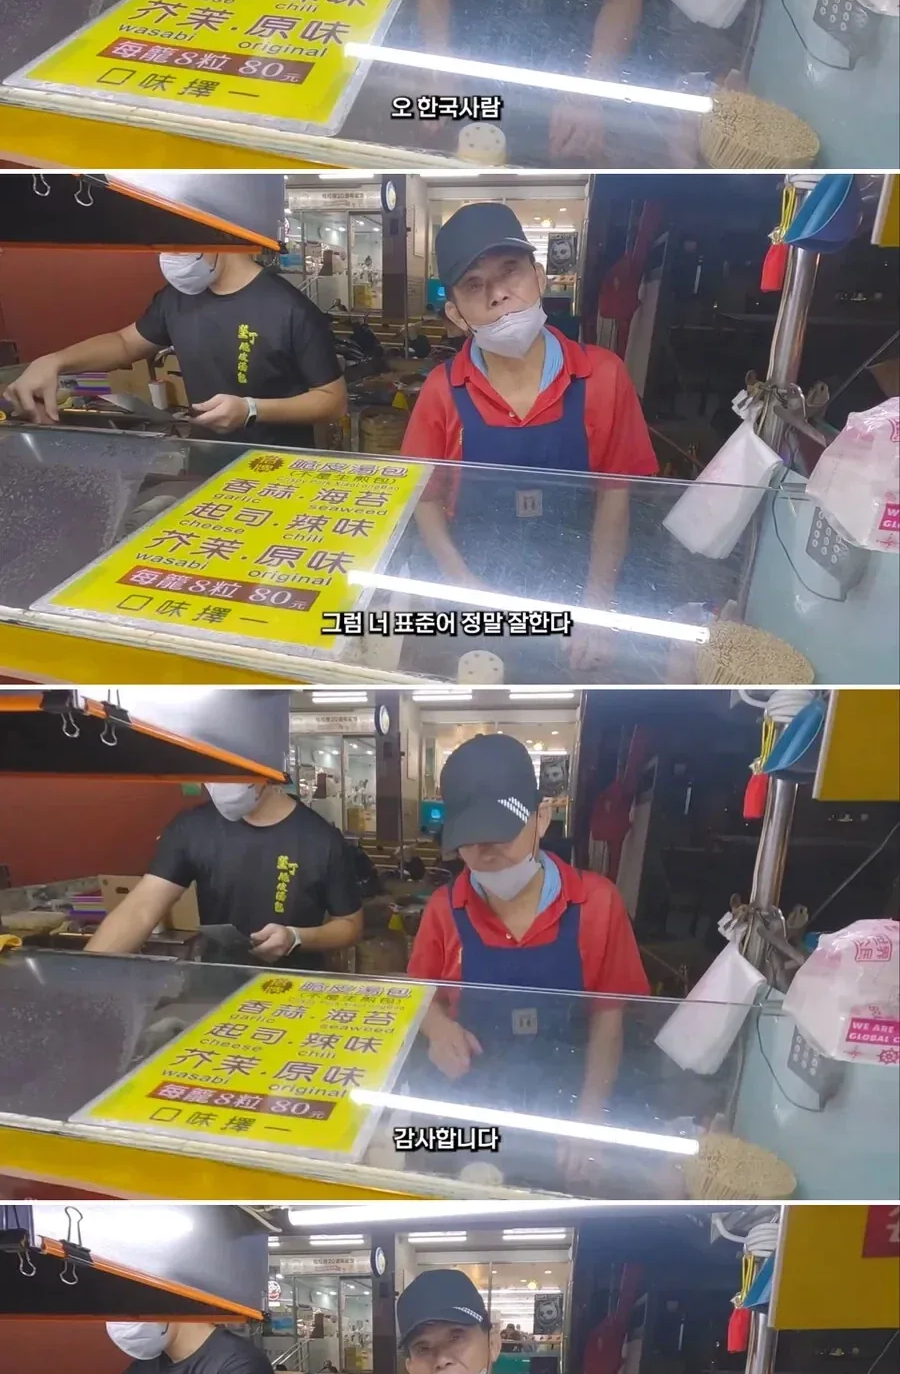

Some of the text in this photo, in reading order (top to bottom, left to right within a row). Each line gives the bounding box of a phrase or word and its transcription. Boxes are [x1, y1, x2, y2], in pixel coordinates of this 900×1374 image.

[274, 2, 317, 13] chili
[118, 24, 327, 57] wasabi original
[212, 493, 388, 516] garlic seaweed
[178, 519, 323, 543] cheese chili
[135, 552, 333, 586] wasabi original
[852, 1022, 895, 1034] WE ARE
[849, 1033, 889, 1043] GLOBAL
[161, 1069, 229, 1085] wasabi
